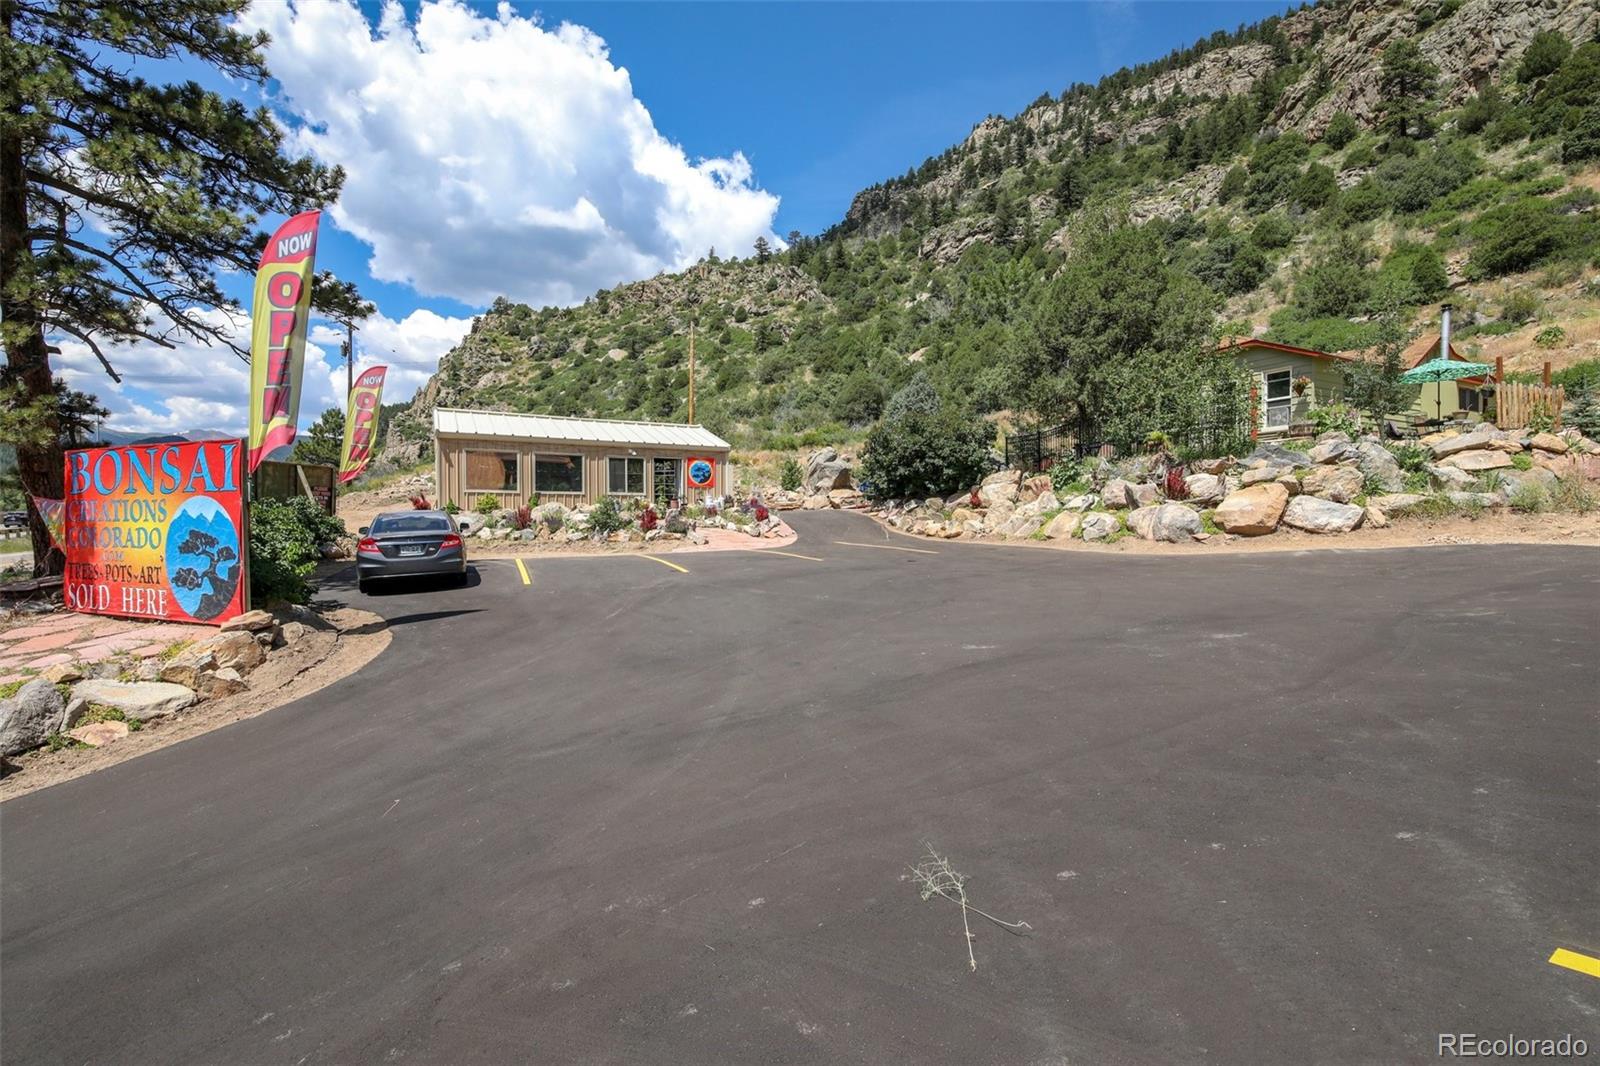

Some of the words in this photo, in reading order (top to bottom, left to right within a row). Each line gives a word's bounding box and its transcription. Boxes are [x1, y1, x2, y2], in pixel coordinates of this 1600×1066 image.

[278, 231, 312, 258] NOW
[262, 271, 304, 424] OPEN
[363, 375, 383, 385] NOW
[70, 443, 238, 495] BONSAI
[68, 526, 161, 549] COLORADO
[68, 583, 110, 610] SOLD
[121, 586, 168, 615] HERE
